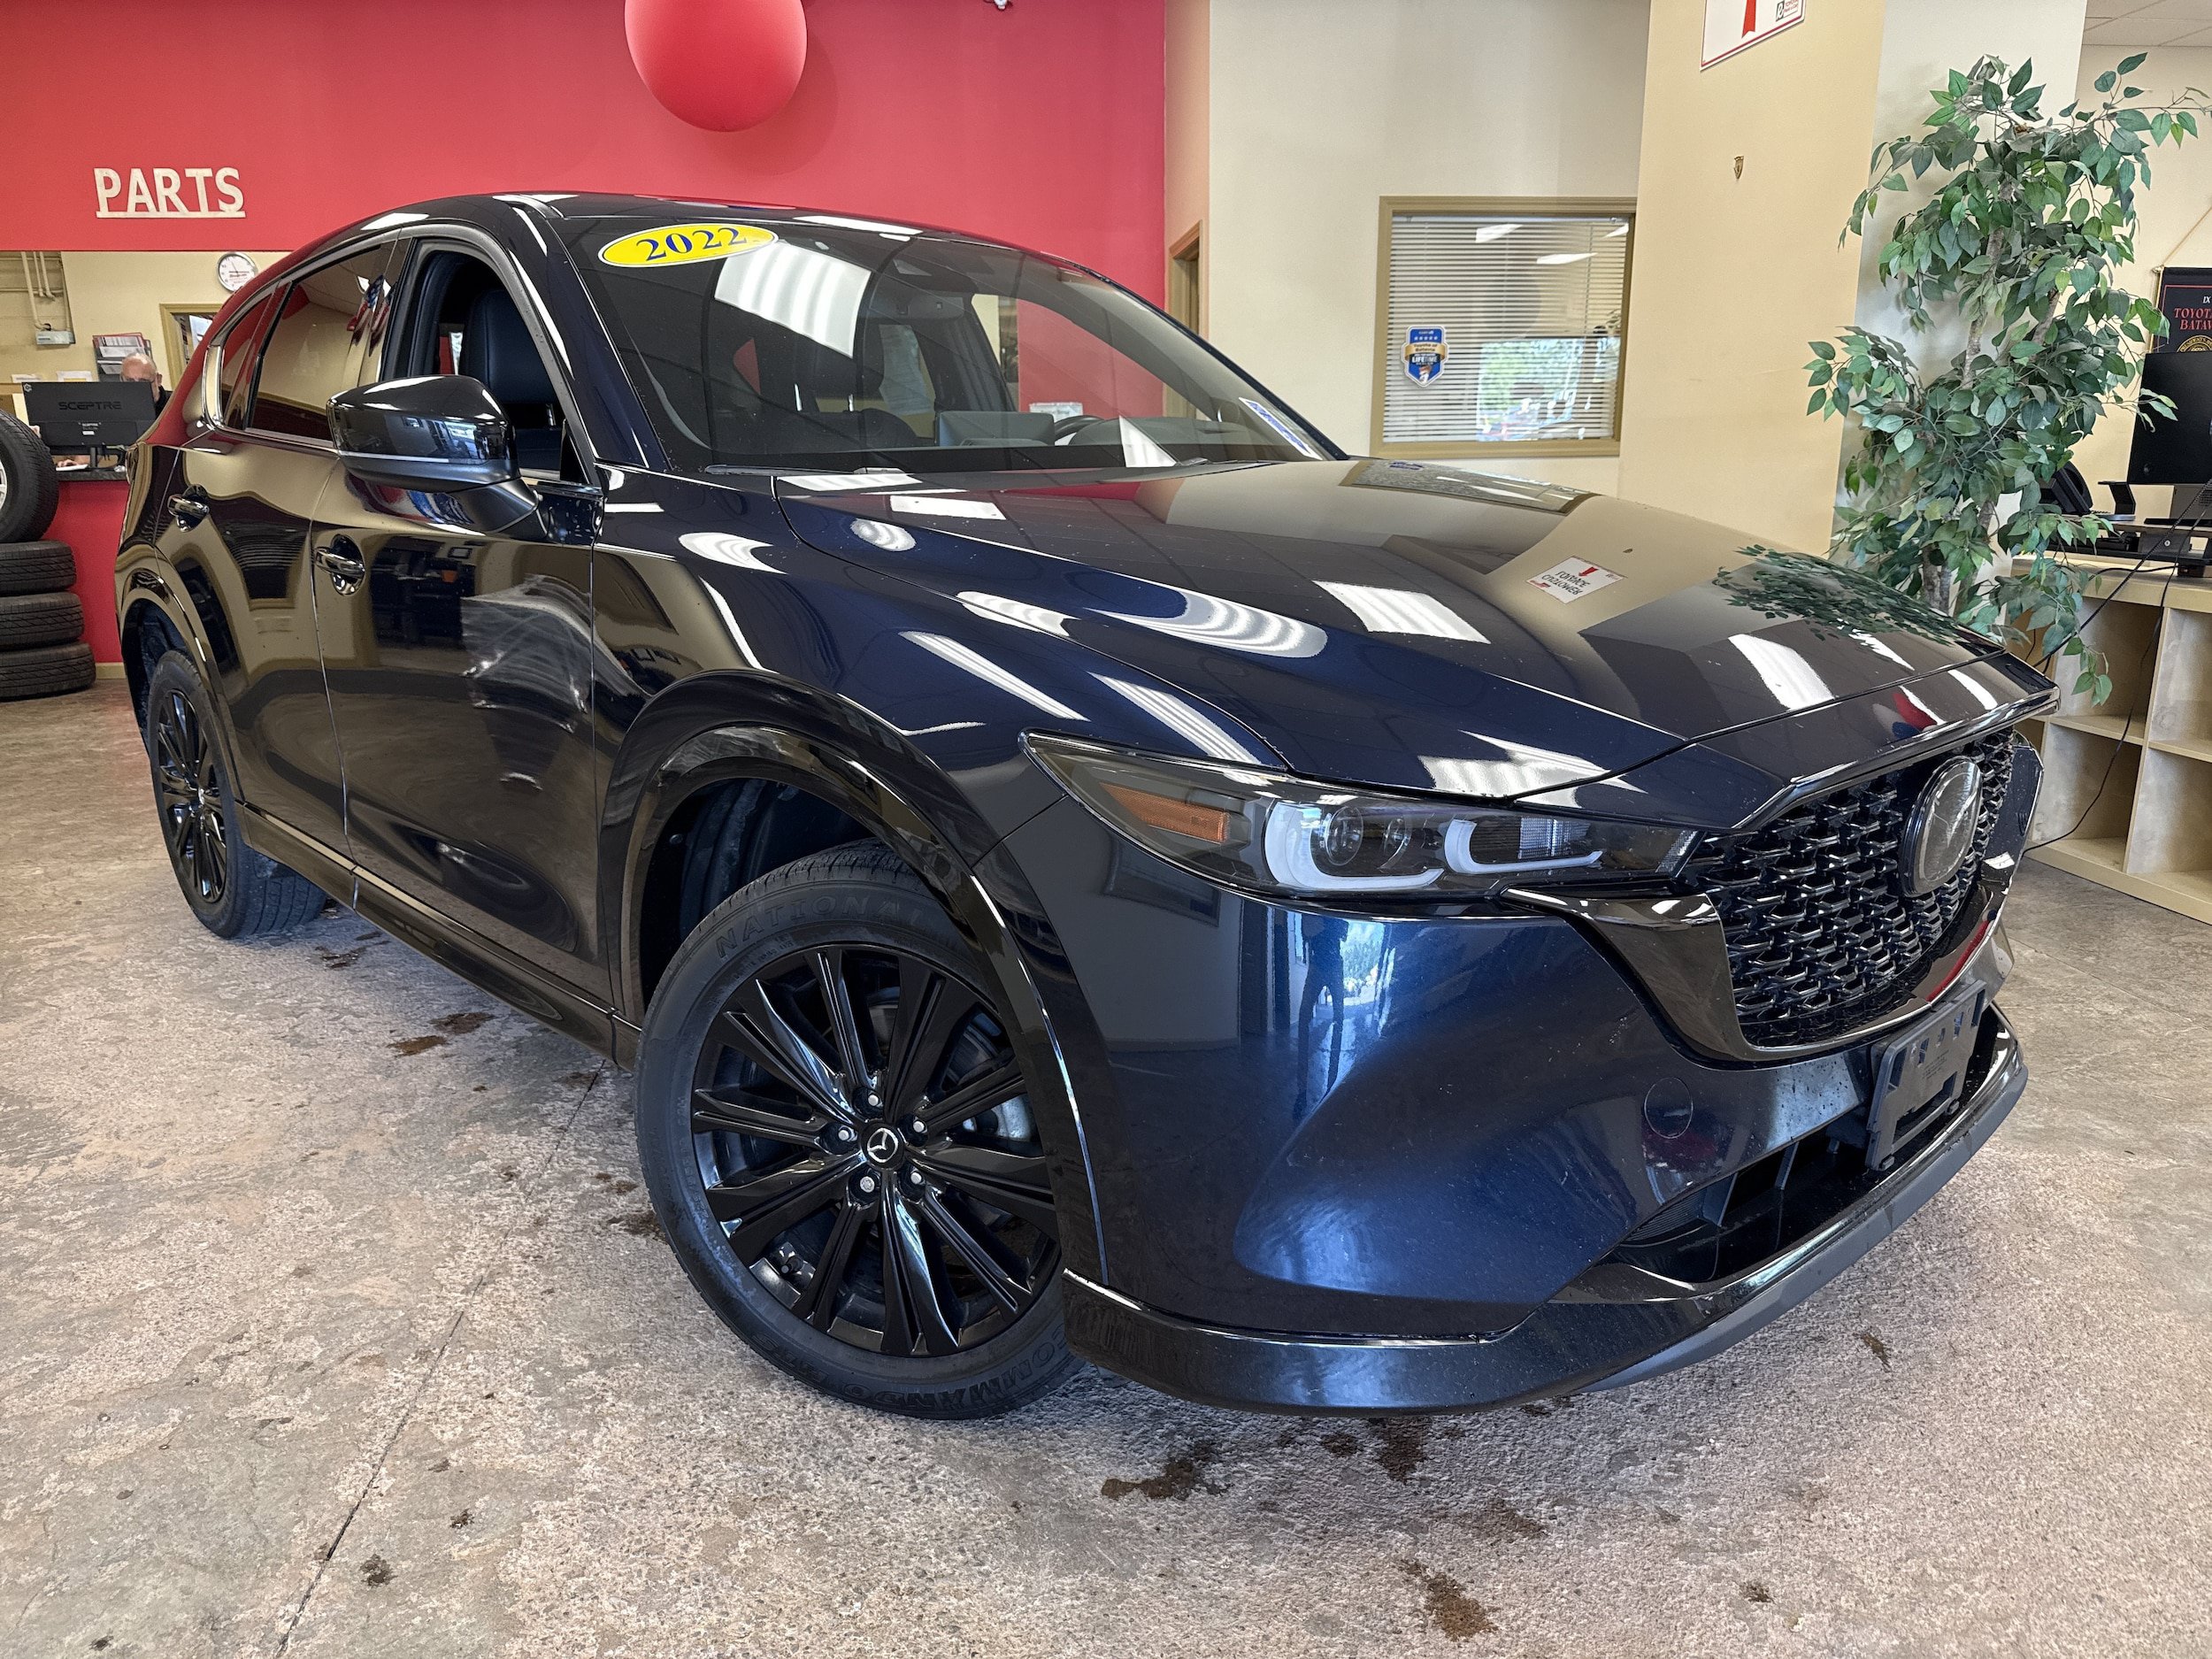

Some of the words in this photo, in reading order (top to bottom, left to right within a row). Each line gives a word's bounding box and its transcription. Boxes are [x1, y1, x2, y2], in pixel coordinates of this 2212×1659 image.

[93, 166, 245, 214] PARTS
[636, 227, 747, 262] 2022
[2174, 307, 2212, 319] TOYOT
[58, 401, 122, 411] SCEPTRE
